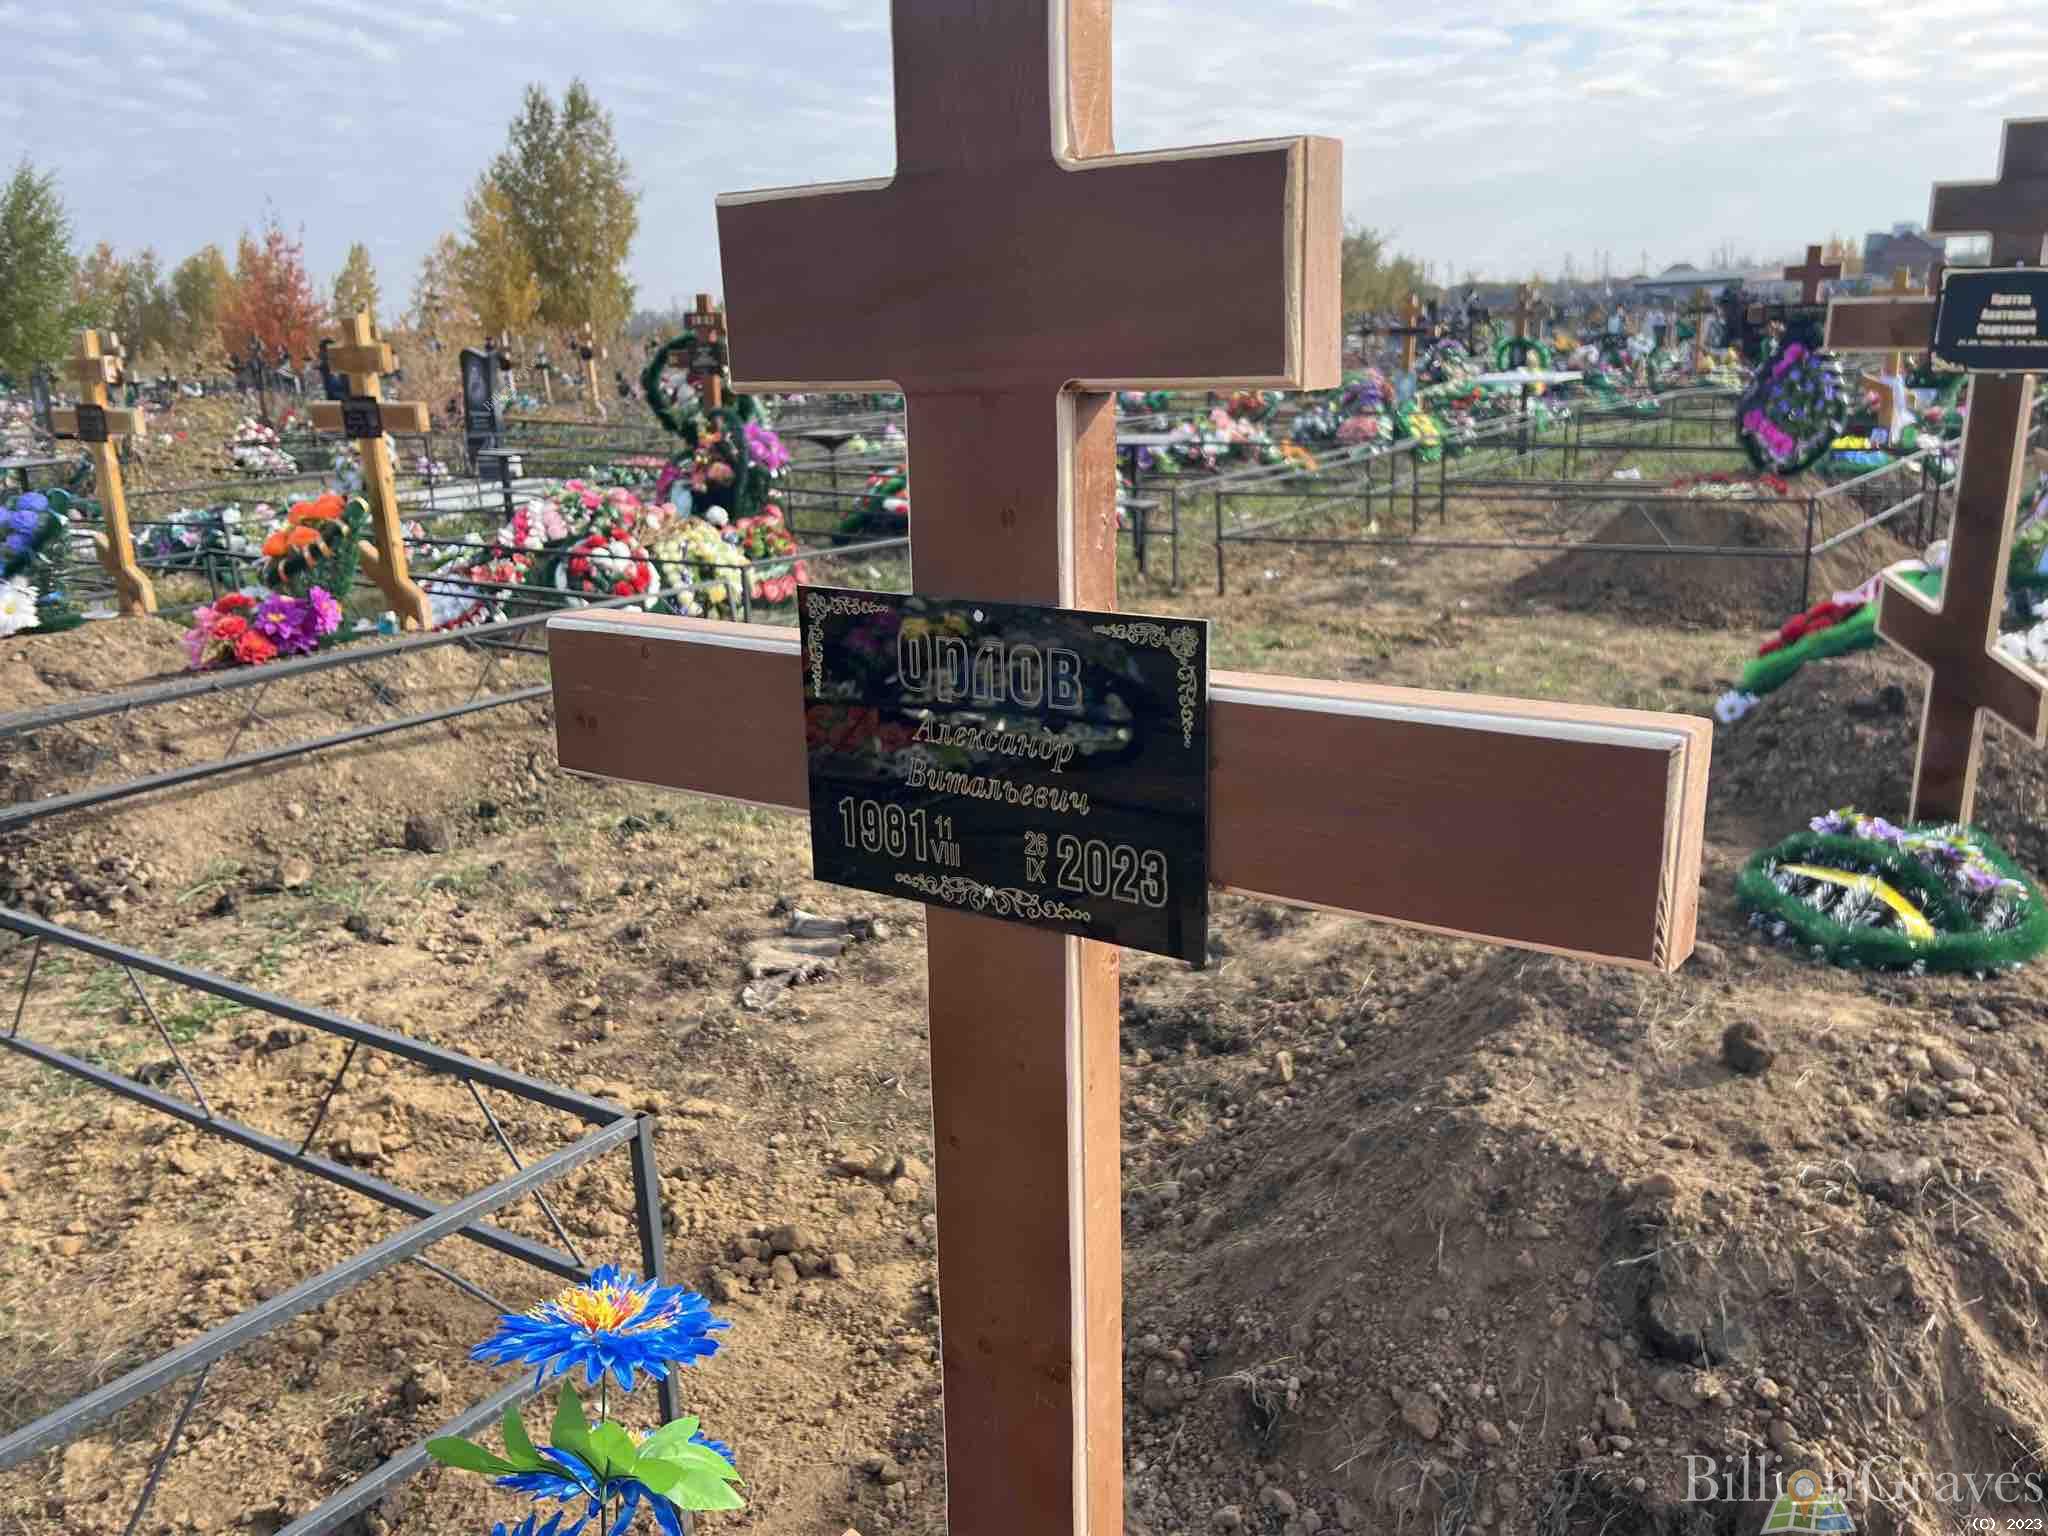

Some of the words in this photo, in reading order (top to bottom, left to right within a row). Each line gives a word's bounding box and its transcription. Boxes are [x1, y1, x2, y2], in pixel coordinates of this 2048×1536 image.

[911, 718, 1074, 774] Александр
[905, 756, 1090, 816] Витальевич
[838, 796, 927, 862] 1981
[934, 815, 952, 840] 11
[1024, 830, 1048, 857] 26
[930, 839, 960, 867] VIII
[1025, 856, 1047, 884] IX
[1056, 834, 1168, 908] 2023
